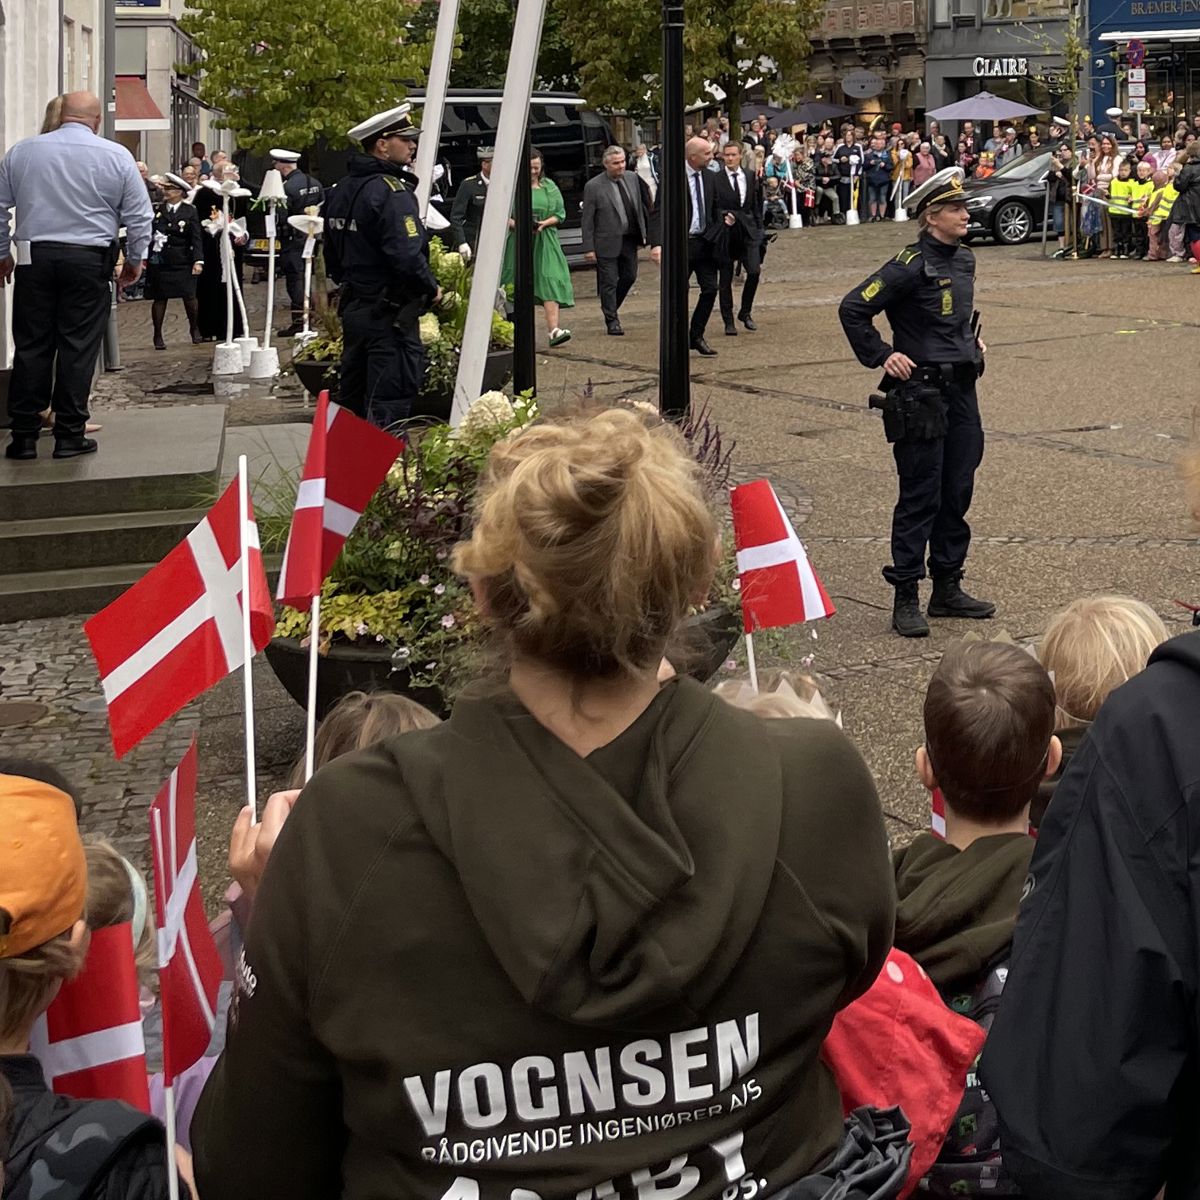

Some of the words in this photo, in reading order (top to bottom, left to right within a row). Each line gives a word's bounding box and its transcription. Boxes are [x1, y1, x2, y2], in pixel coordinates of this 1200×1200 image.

[972, 56, 1029, 77] CLAIRE
[403, 1012, 761, 1137] VOGNSEN
[420, 1124, 574, 1166] RÅDGIVENDE
[578, 1102, 724, 1146] INGENIØRER
[729, 1077, 763, 1113] A/S
